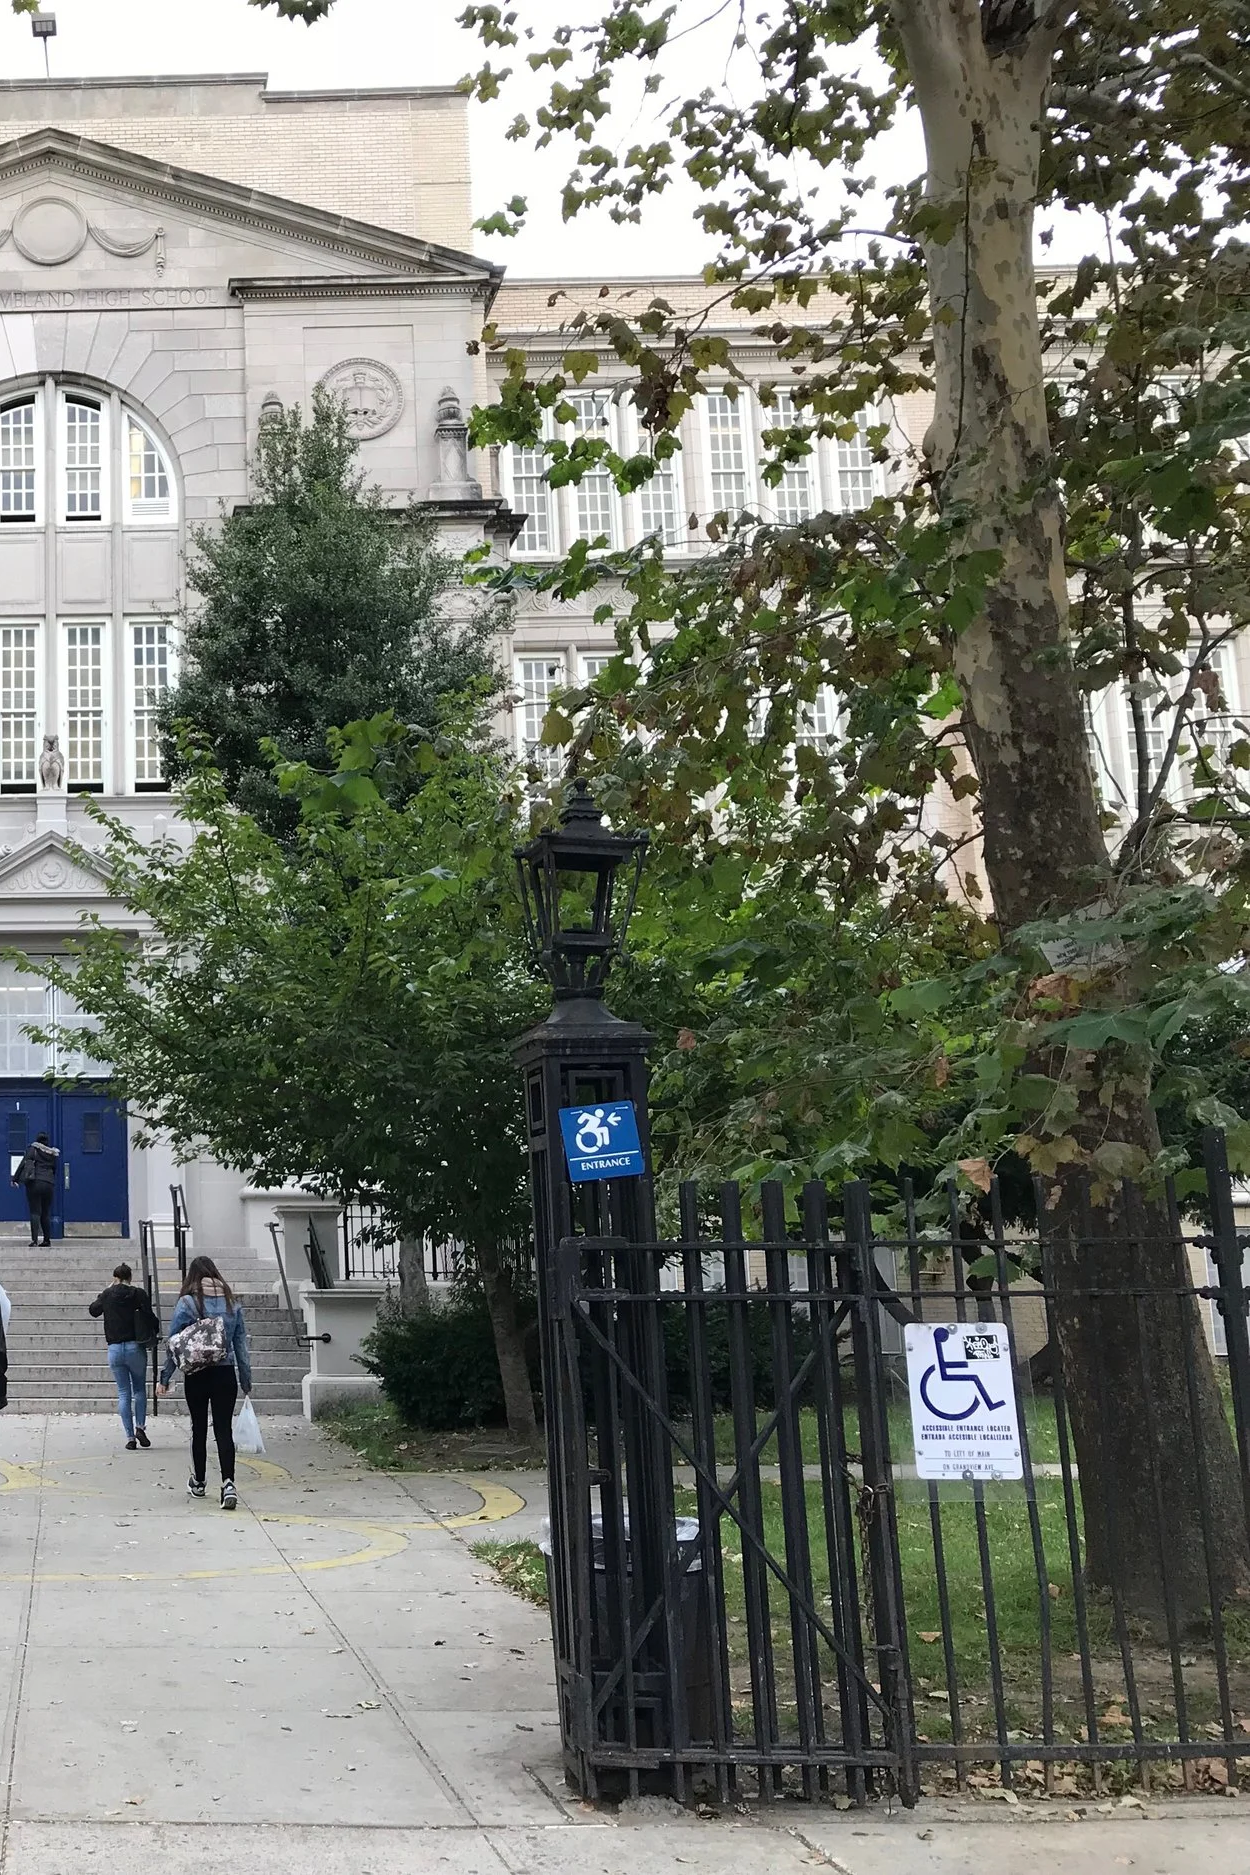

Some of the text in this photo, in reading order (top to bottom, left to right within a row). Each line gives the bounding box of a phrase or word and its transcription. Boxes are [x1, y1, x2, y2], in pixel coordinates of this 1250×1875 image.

[86, 290, 131, 307] HIGH
[141, 289, 218, 306] SCHOOL
[16, 1102, 20, 1111] 1
[581, 1157, 631, 1171] ENTRANCE
